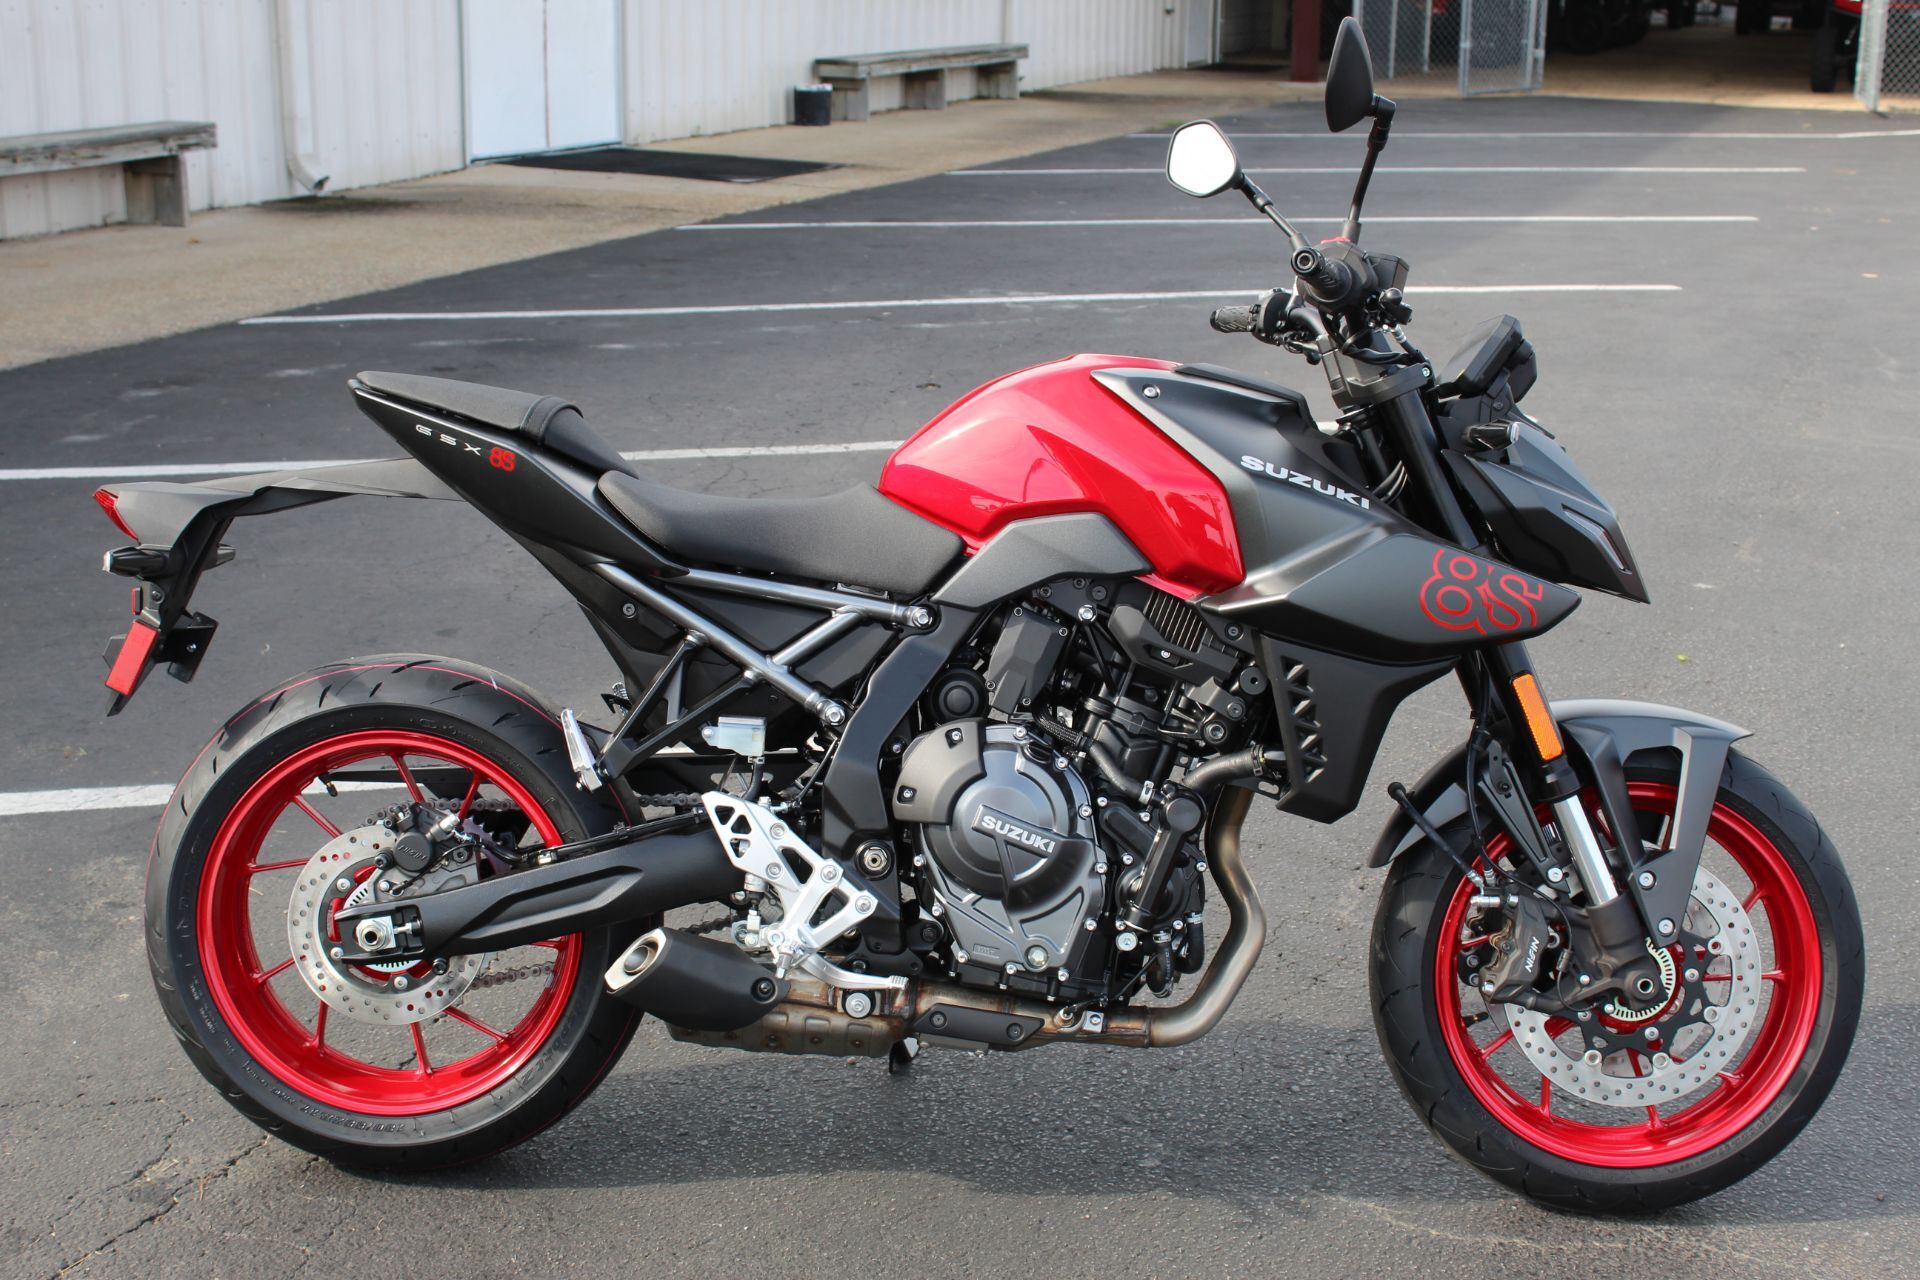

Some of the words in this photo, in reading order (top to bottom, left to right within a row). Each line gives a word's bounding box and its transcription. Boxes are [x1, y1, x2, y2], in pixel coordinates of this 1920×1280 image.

[488, 446, 517, 473] 8S
[1240, 455, 1370, 510] SUZUKI
[981, 815, 1056, 854] SUZUKI
